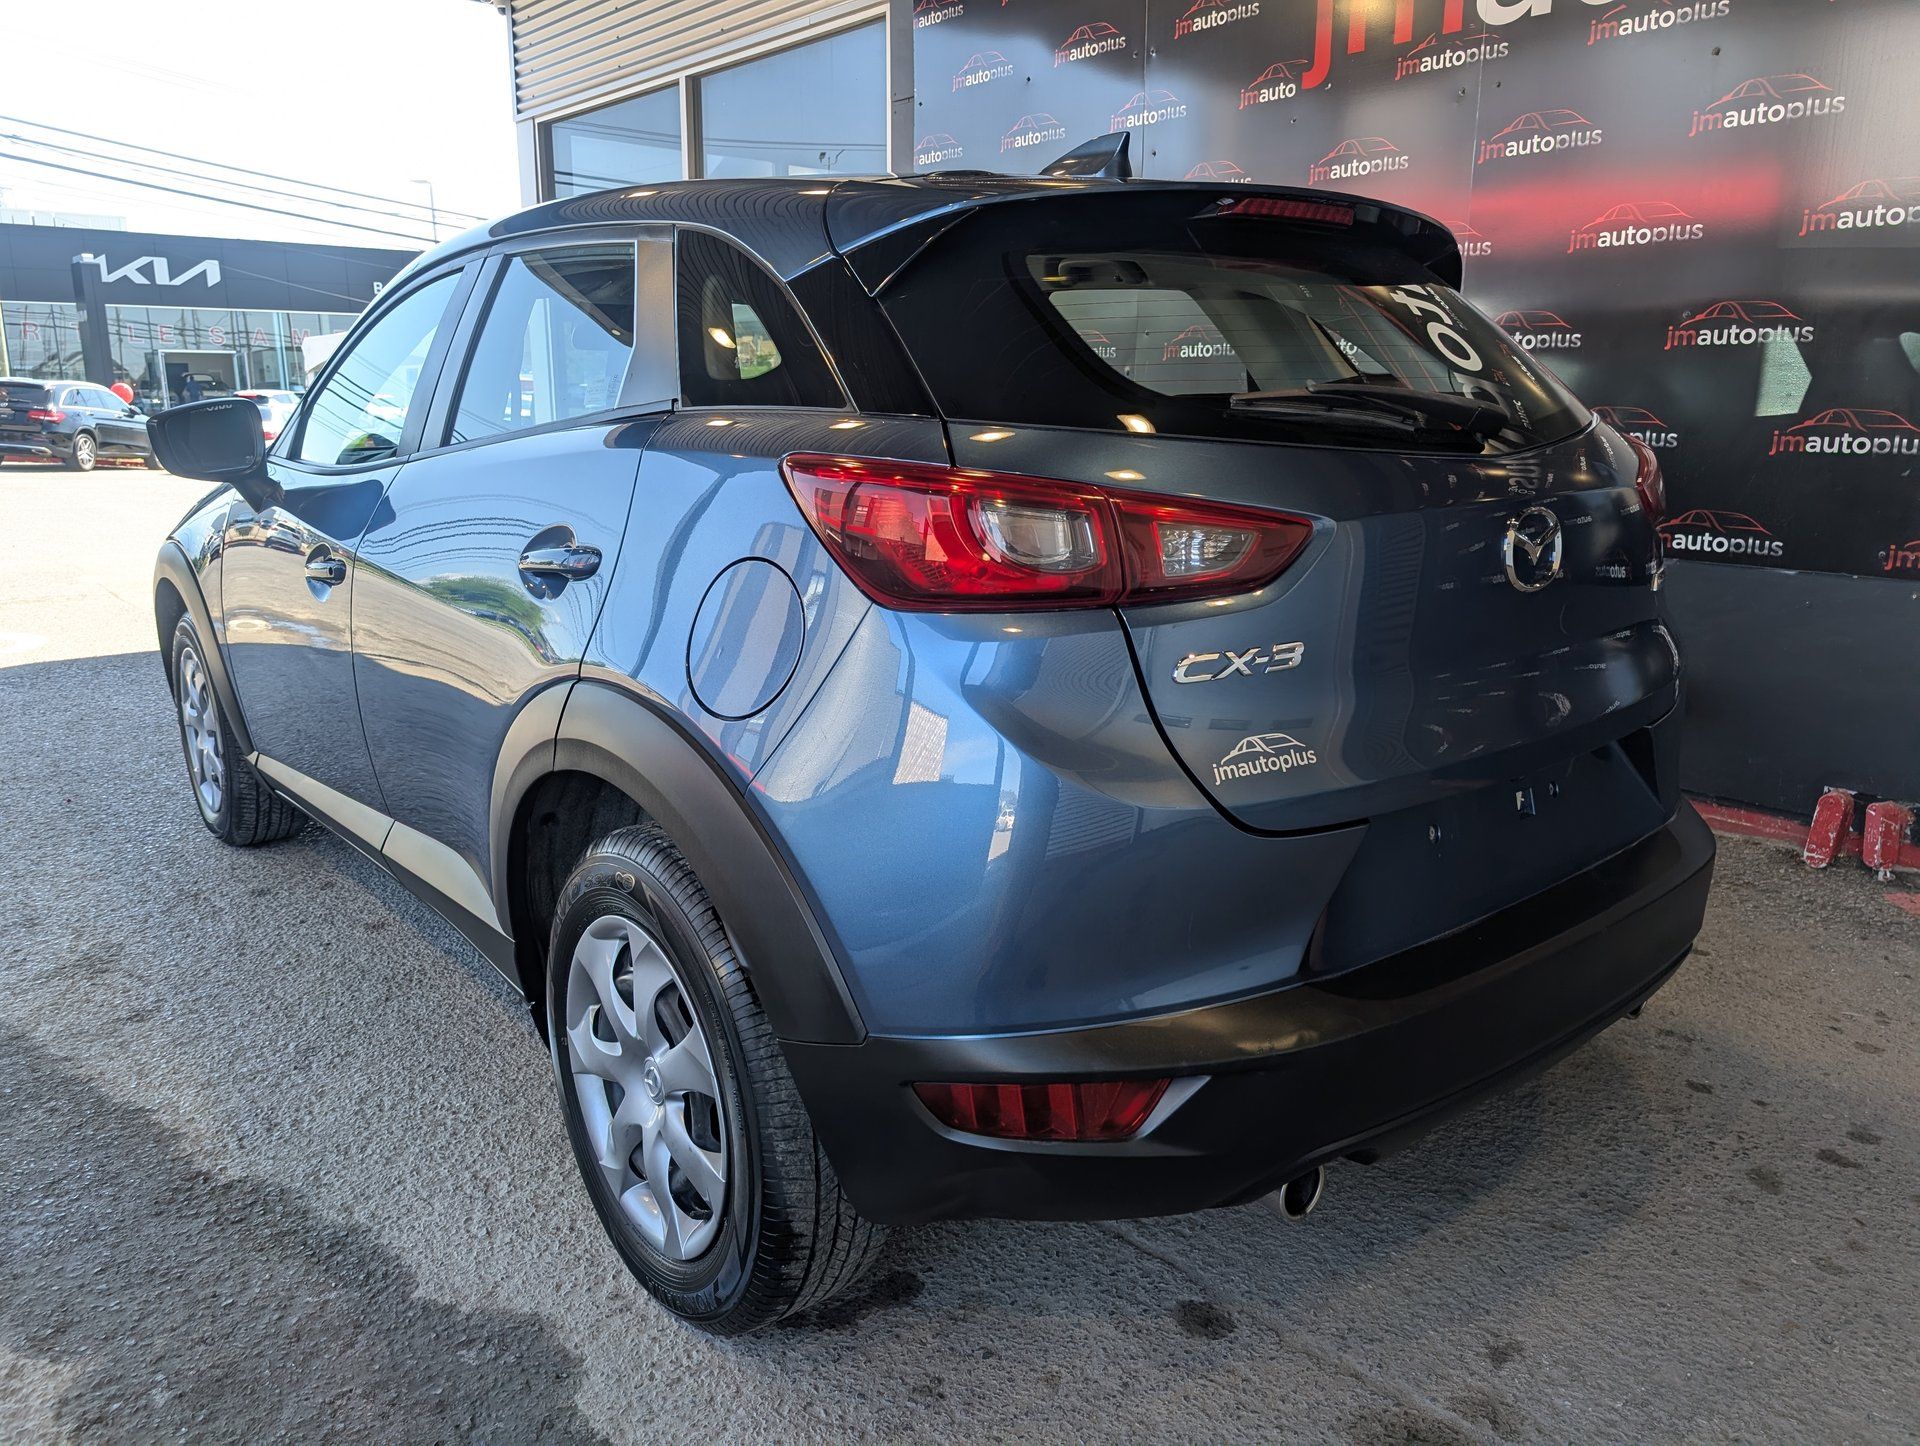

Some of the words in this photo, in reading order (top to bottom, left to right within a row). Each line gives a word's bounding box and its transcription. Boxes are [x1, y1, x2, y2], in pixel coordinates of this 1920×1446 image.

[1174, 2, 1260, 39] jmautoplus
[1588, 0, 1730, 46] jmautoplus
[1054, 34, 1126, 68] jmautoplus
[1394, 40, 1509, 81] jmautoplus
[952, 62, 1014, 93] jmautoplus
[1238, 80, 1297, 111] jmauto
[1109, 103, 1187, 133] jmautoplus
[1689, 95, 1846, 137] jmautoplus
[1000, 125, 1066, 153] jmautoplus
[1477, 128, 1602, 164] jmautoplus
[1308, 154, 1409, 186] jmautoplus
[1799, 202, 1920, 237] jmautop
[1567, 221, 1704, 254] jmautoplus
[94, 253, 221, 288] KIA
[1664, 324, 1815, 350] jmautoplus
[1768, 430, 1919, 456] jmautoplu
[1171, 641, 1306, 684] CX-3
[1212, 746, 1317, 785] jmautoplus
